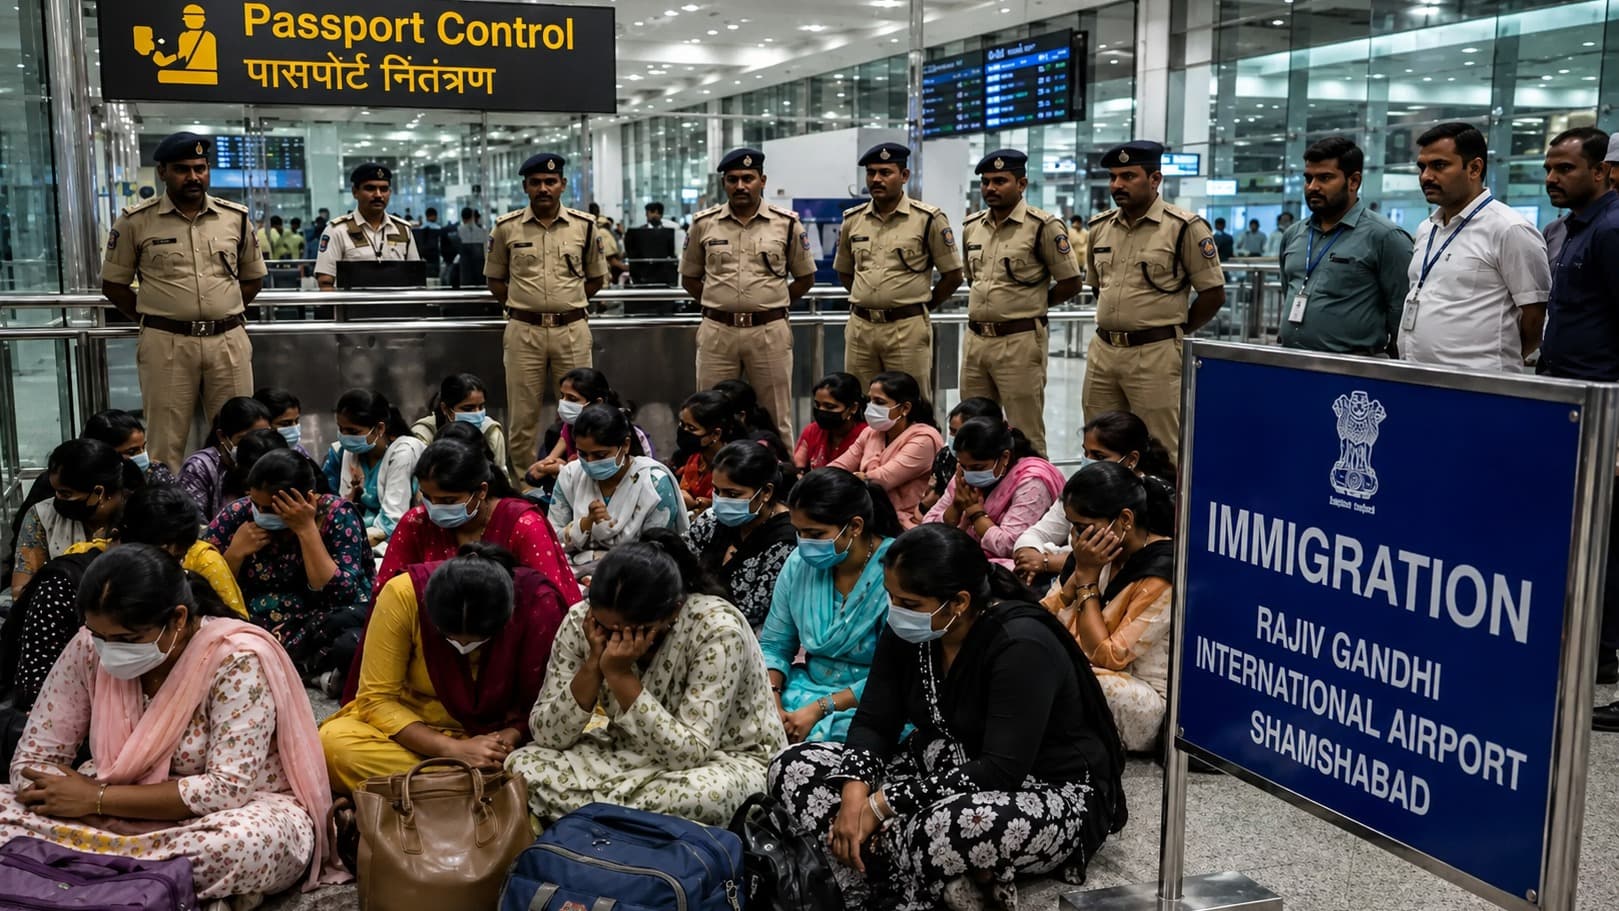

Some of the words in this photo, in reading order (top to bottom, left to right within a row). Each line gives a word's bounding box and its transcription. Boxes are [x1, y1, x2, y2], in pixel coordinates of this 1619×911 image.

[243, 2, 425, 49] Passport
[437, 10, 574, 50] Control
[1207, 501, 1532, 644] IMMIGRATION
[1257, 605, 1326, 659] RAJIV
[1332, 631, 1441, 701] GANDHI
[1196, 635, 1381, 739] INTERNATIONAL
[1387, 708, 1528, 791] AIRPORT
[1250, 710, 1430, 816] SHAMSHABAD
